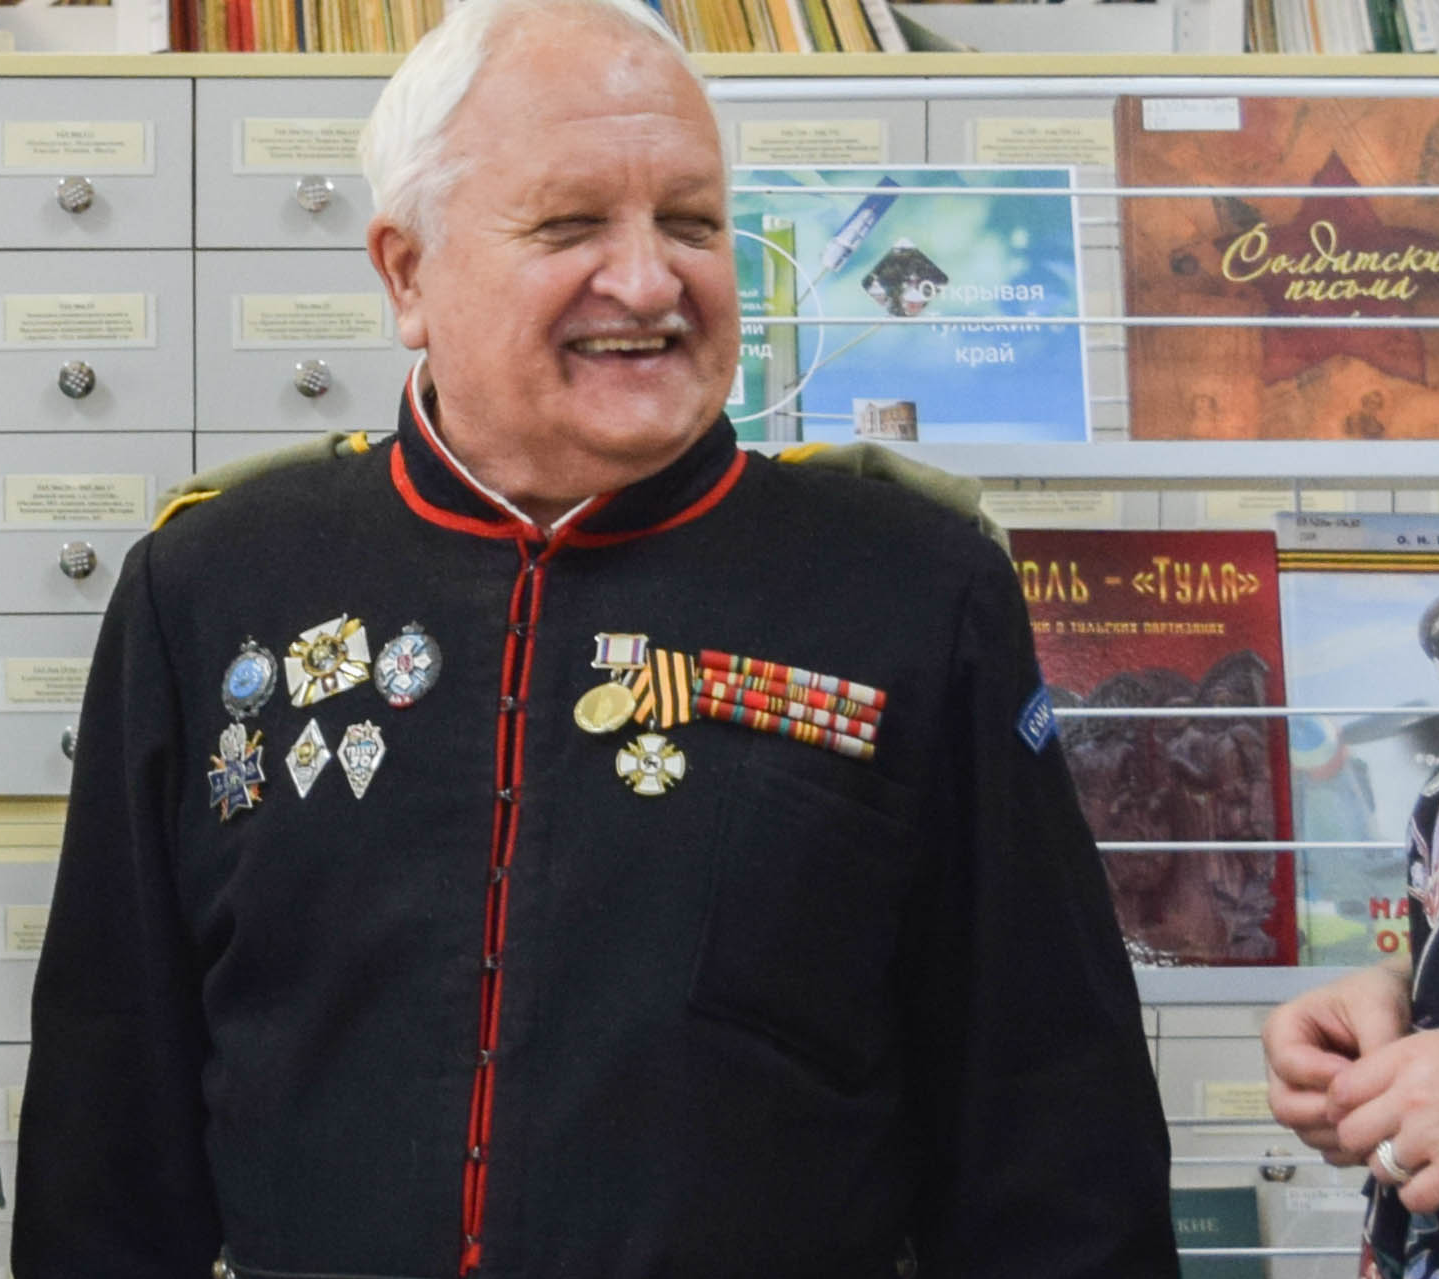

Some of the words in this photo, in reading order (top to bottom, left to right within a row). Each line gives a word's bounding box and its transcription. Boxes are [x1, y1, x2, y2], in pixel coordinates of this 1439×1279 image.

[919, 280, 1045, 304] Открывая
[1284, 275, 1419, 301] письма
[955, 344, 1015, 365] край
